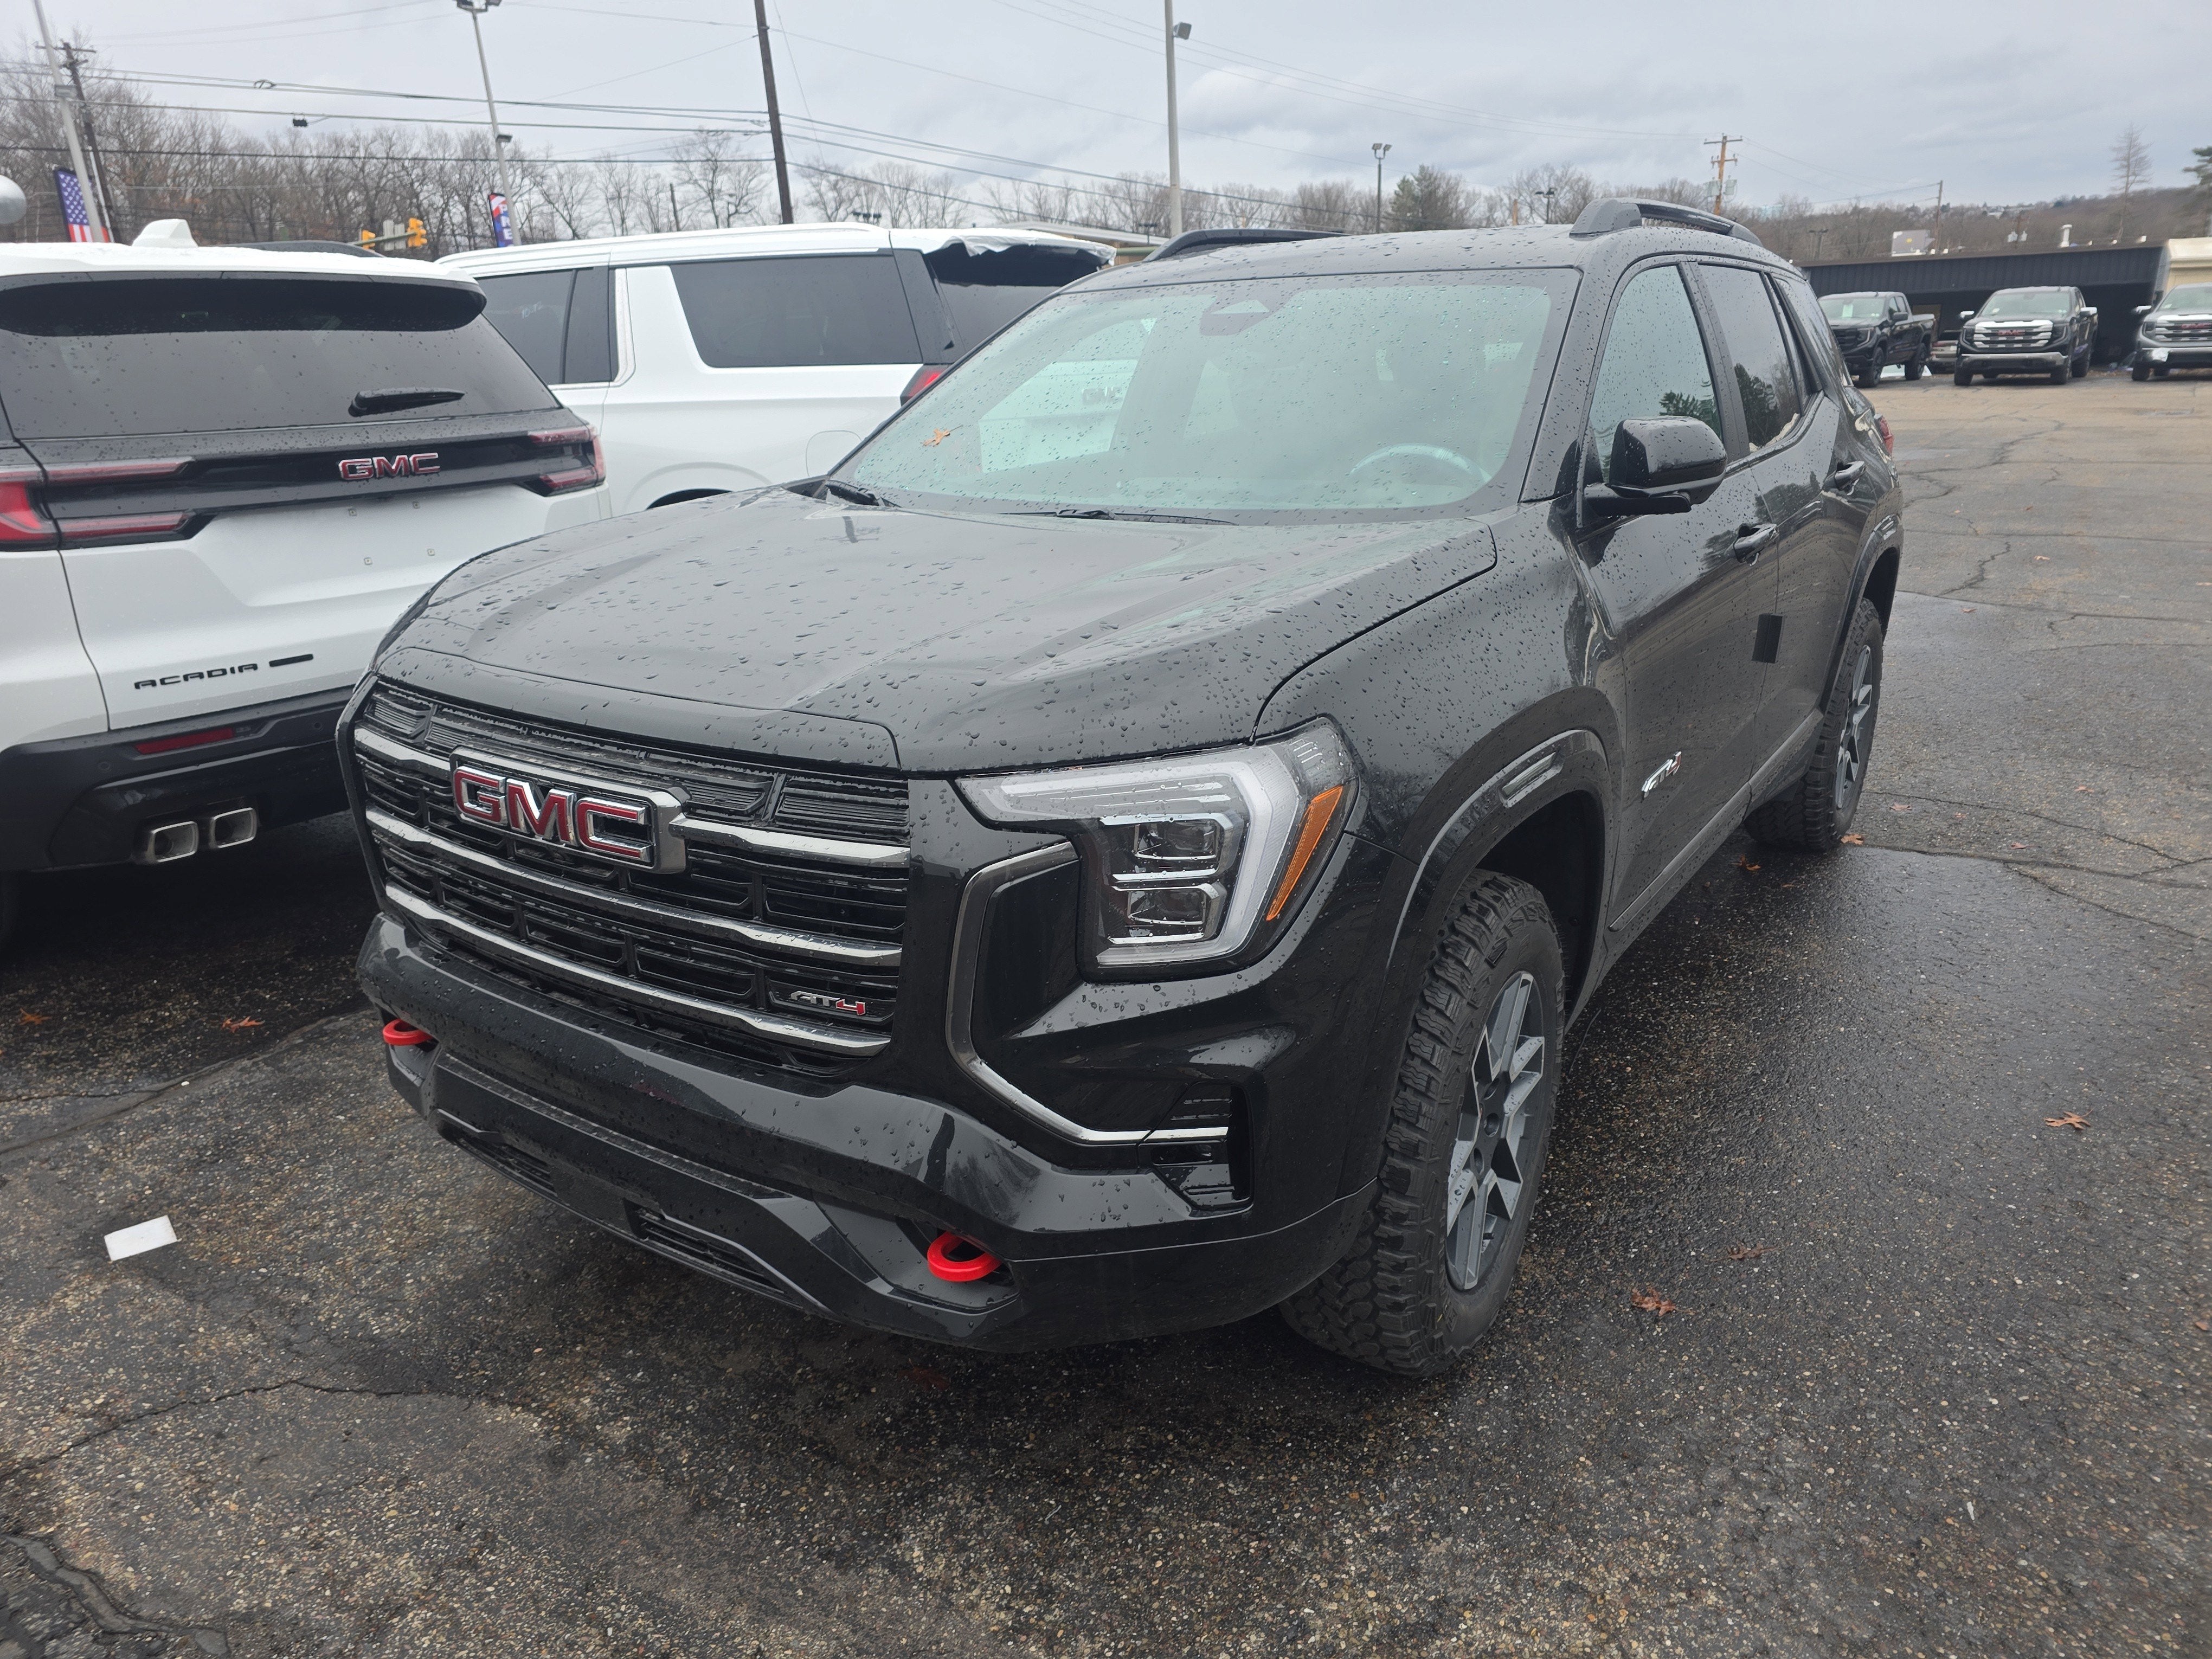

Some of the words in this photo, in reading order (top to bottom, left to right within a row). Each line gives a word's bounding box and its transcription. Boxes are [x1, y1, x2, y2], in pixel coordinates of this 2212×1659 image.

[339, 453, 441, 480] GMC
[134, 664, 258, 690] ACADIA
[1641, 751, 1681, 798] AT4
[453, 766, 653, 863] GMC
[790, 991, 865, 1015] AT4
